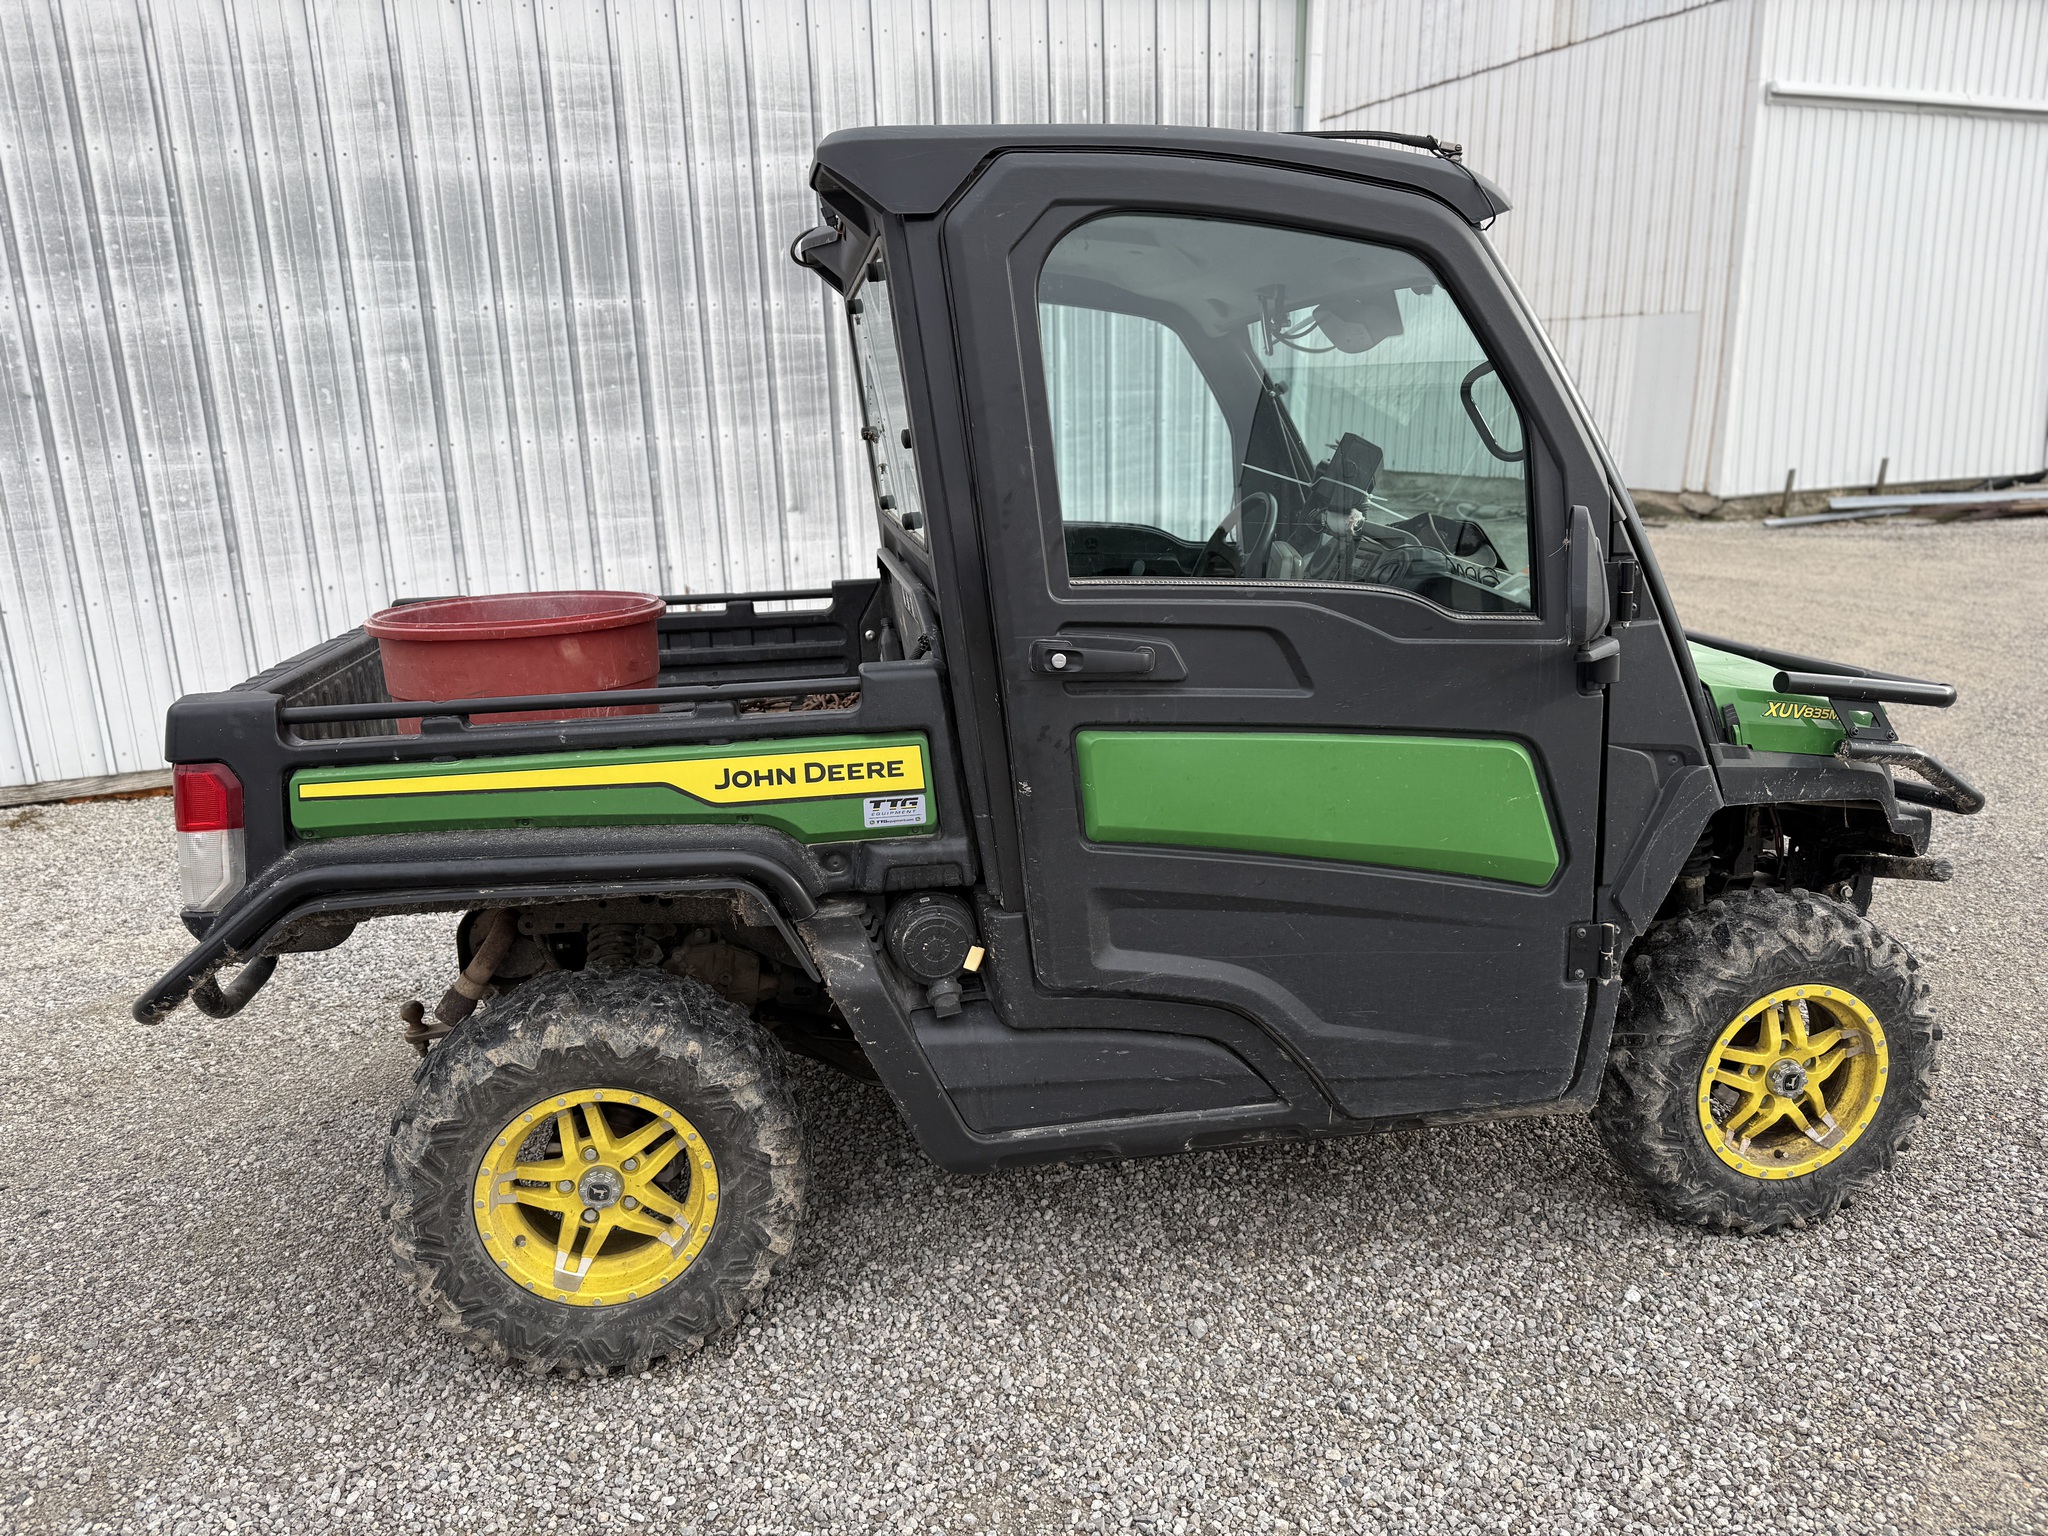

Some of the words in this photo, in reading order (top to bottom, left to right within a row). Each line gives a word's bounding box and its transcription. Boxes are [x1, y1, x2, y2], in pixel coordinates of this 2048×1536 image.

[714, 767, 796, 790] JOHN
[804, 760, 905, 784] DEERE
[869, 797, 919, 811] TTG
